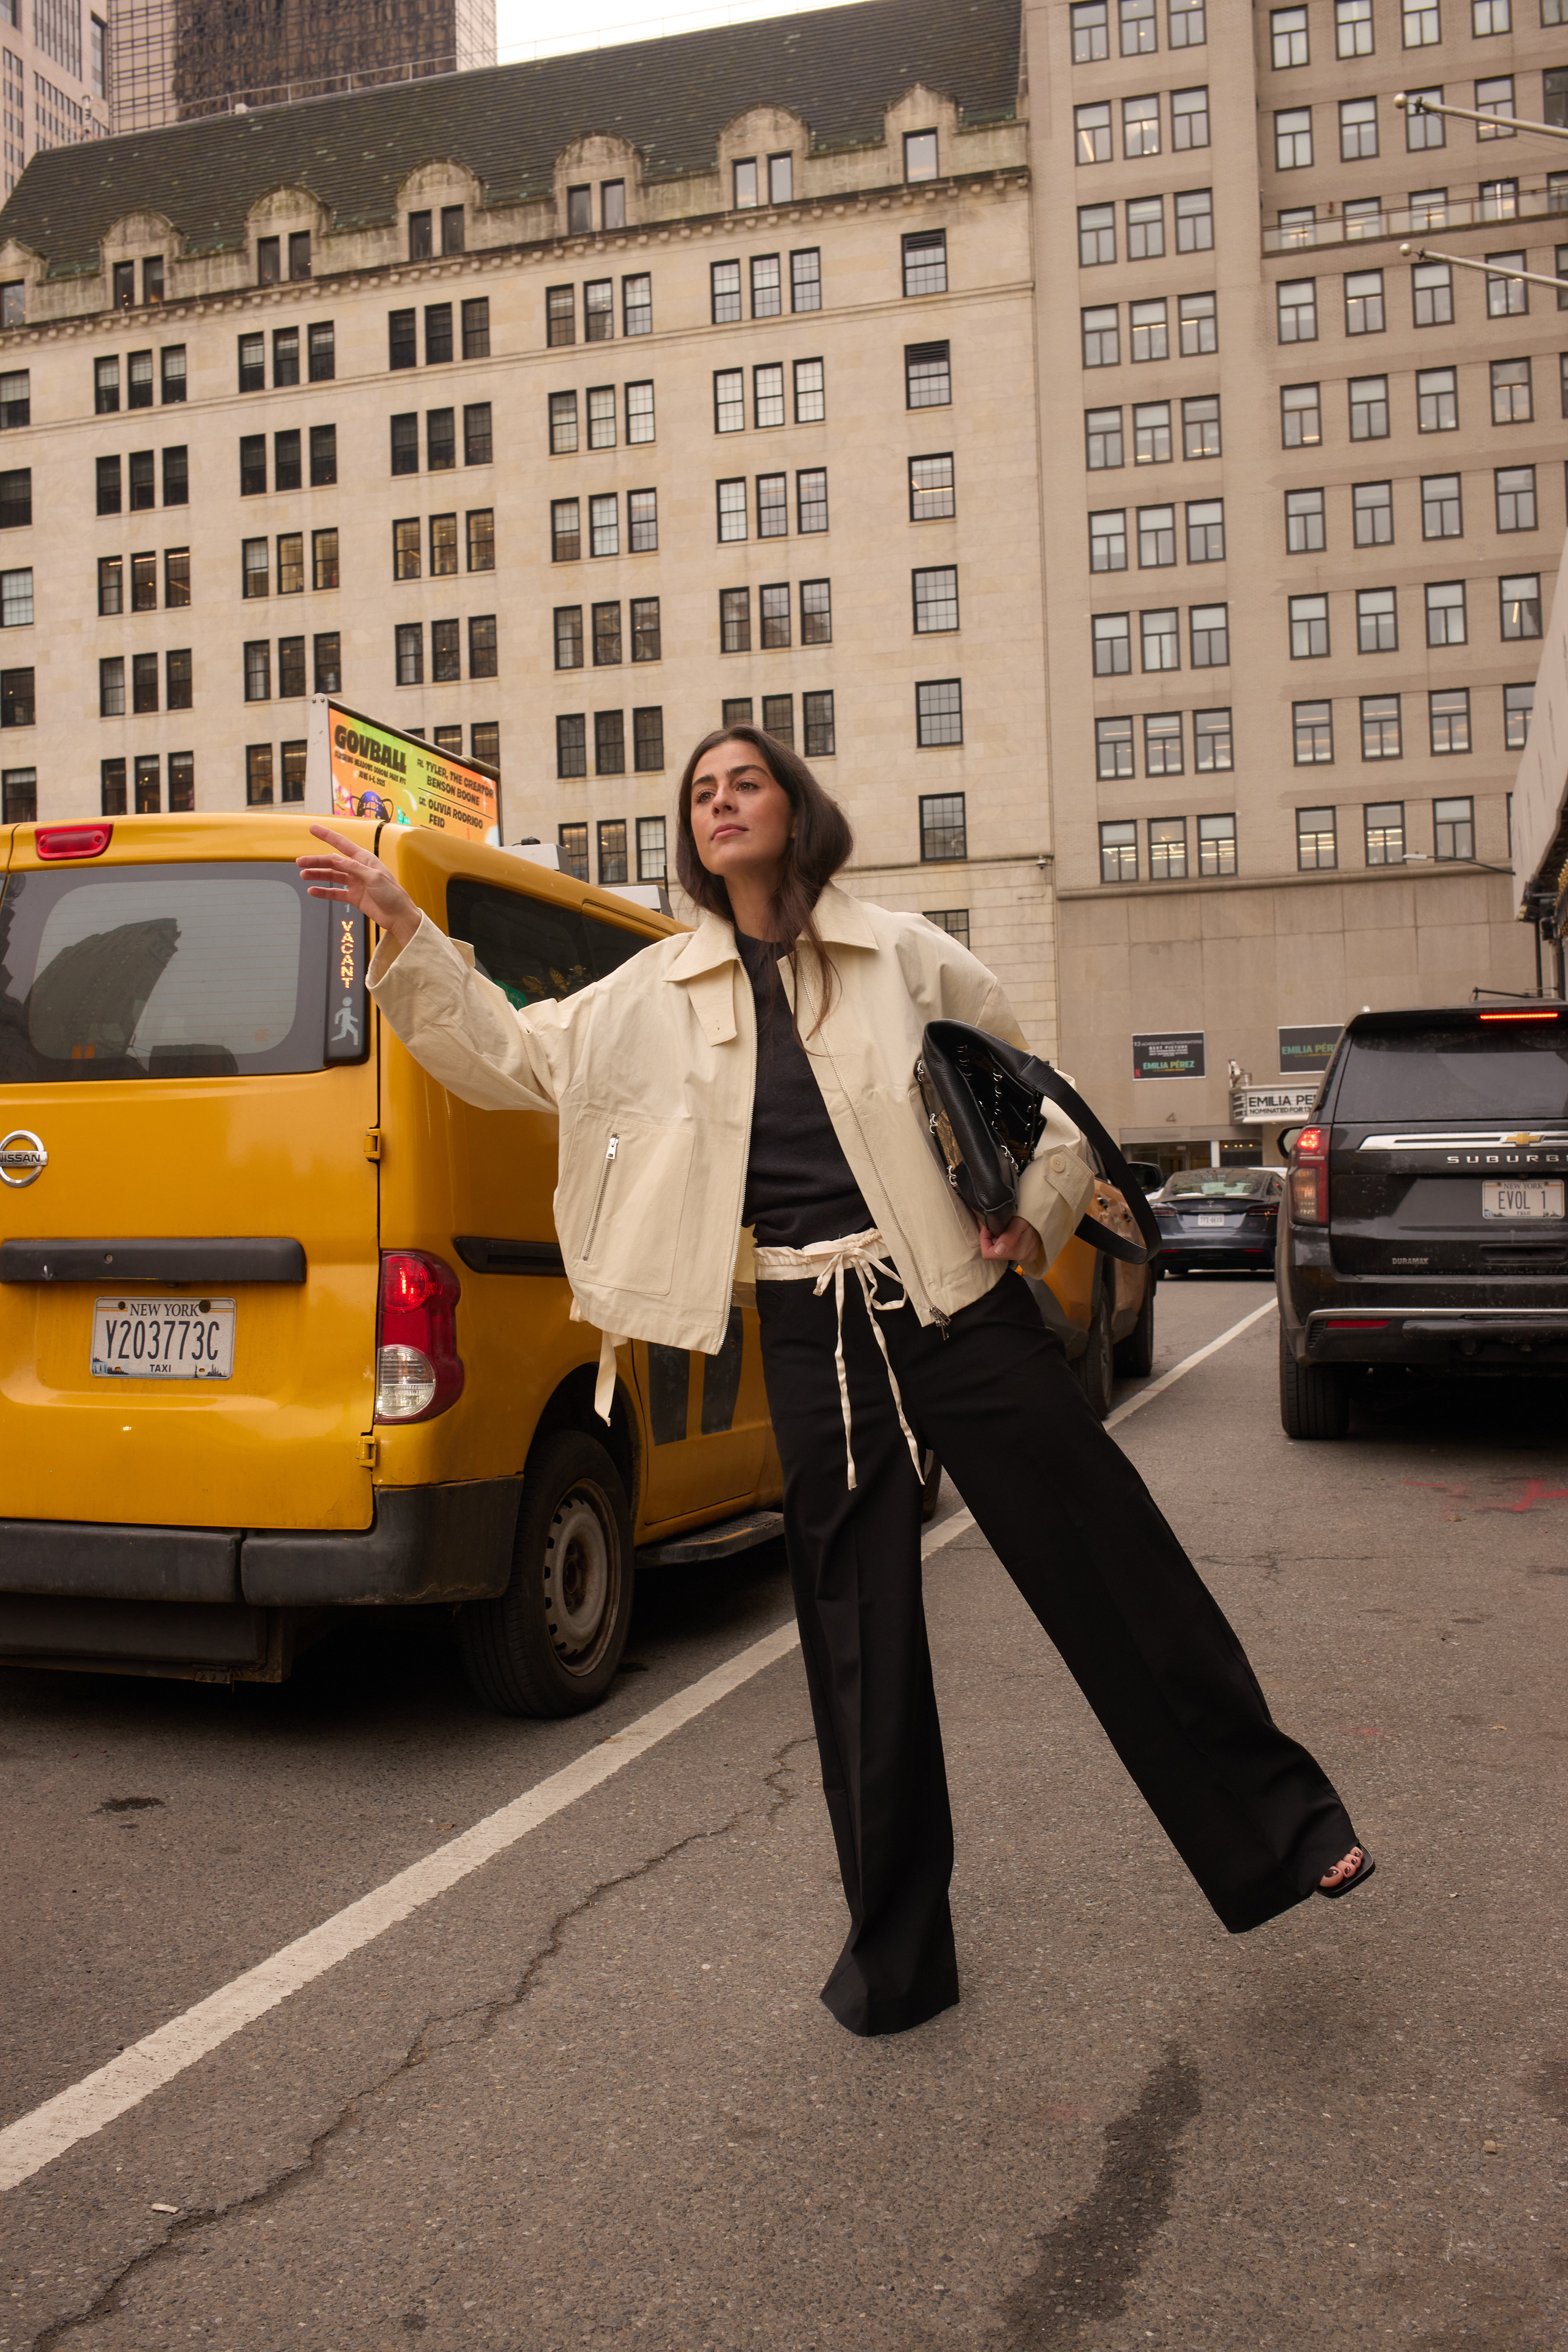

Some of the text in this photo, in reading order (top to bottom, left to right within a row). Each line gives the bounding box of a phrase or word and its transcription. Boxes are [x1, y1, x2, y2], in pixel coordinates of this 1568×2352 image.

[335, 724, 406, 775] GOVBALL
[426, 760, 448, 780] TYLER,
[449, 770, 462, 785] THE
[463, 777, 494, 799] CREATOR
[427, 775, 480, 807] BENSON BOONE
[428, 799, 452, 817] OLIVIA
[452, 808, 483, 830] RODRIGO
[429, 813, 445, 828] FEID
[340, 920, 355, 988] VACANT
[1281, 1045, 1313, 1055] EMILIA
[1142, 1060, 1195, 1070] EMILIA PÉREZ
[1249, 1095, 1316, 1107] EMILIA PE
[1447, 1155, 1568, 1164] SUBURB
[1499, 1191, 1546, 1210] EVOL 1
[130, 1304, 200, 1317] NEW YORK
[106, 1320, 220, 1360] Y203773C
[150, 1364, 171, 1372] TAXI
